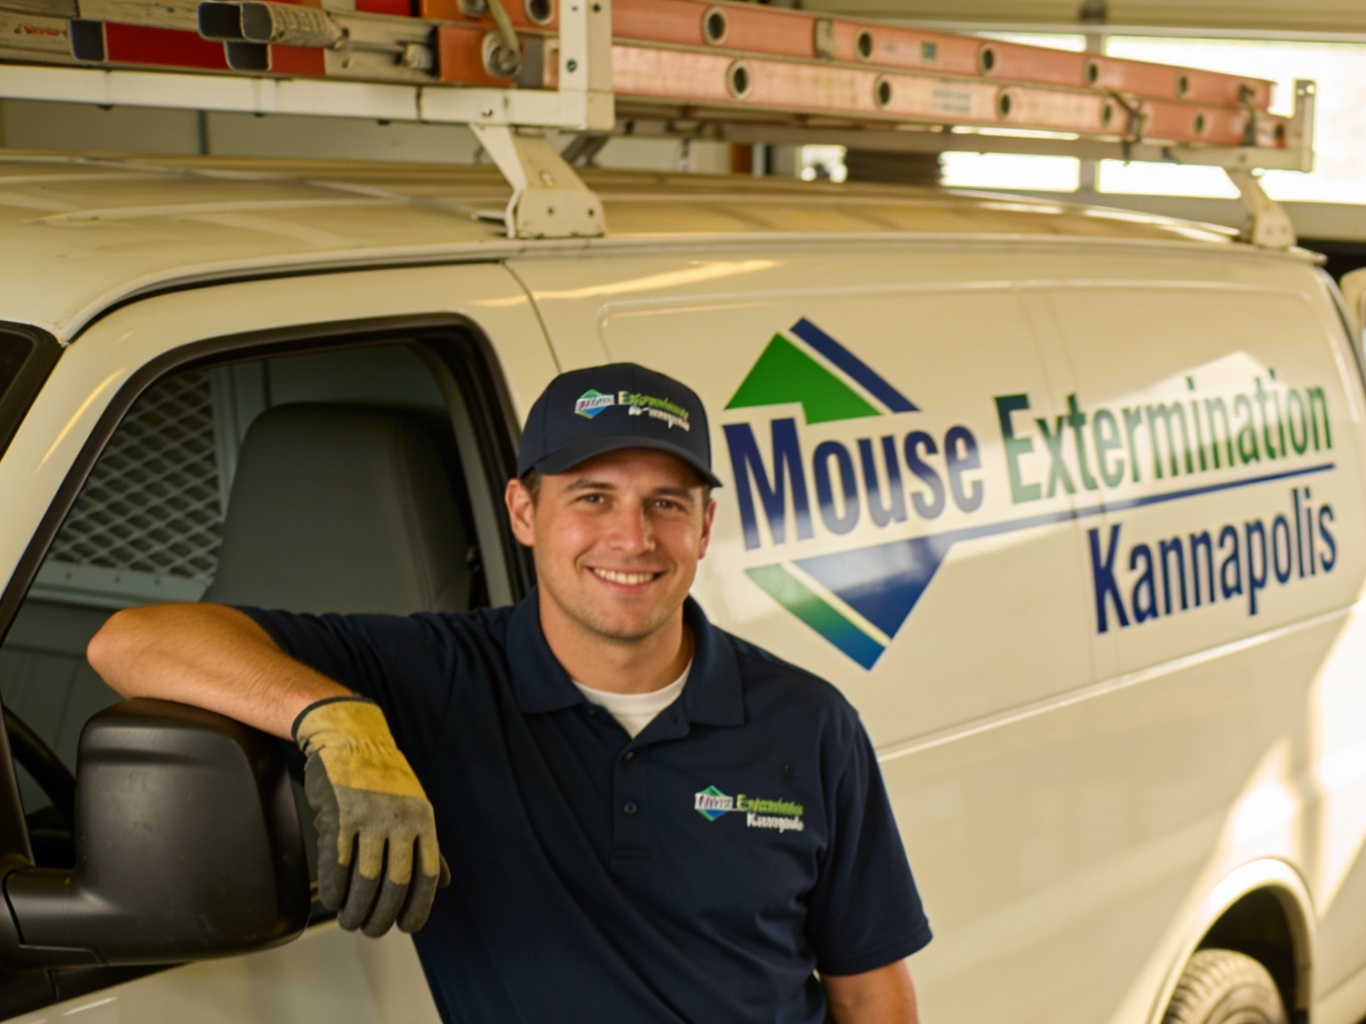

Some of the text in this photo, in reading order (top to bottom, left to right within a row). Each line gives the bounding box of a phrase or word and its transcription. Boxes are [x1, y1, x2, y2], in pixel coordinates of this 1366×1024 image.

[721, 368, 1334, 551] Mouse Extermination
[1087, 486, 1338, 635] Kannapolis
